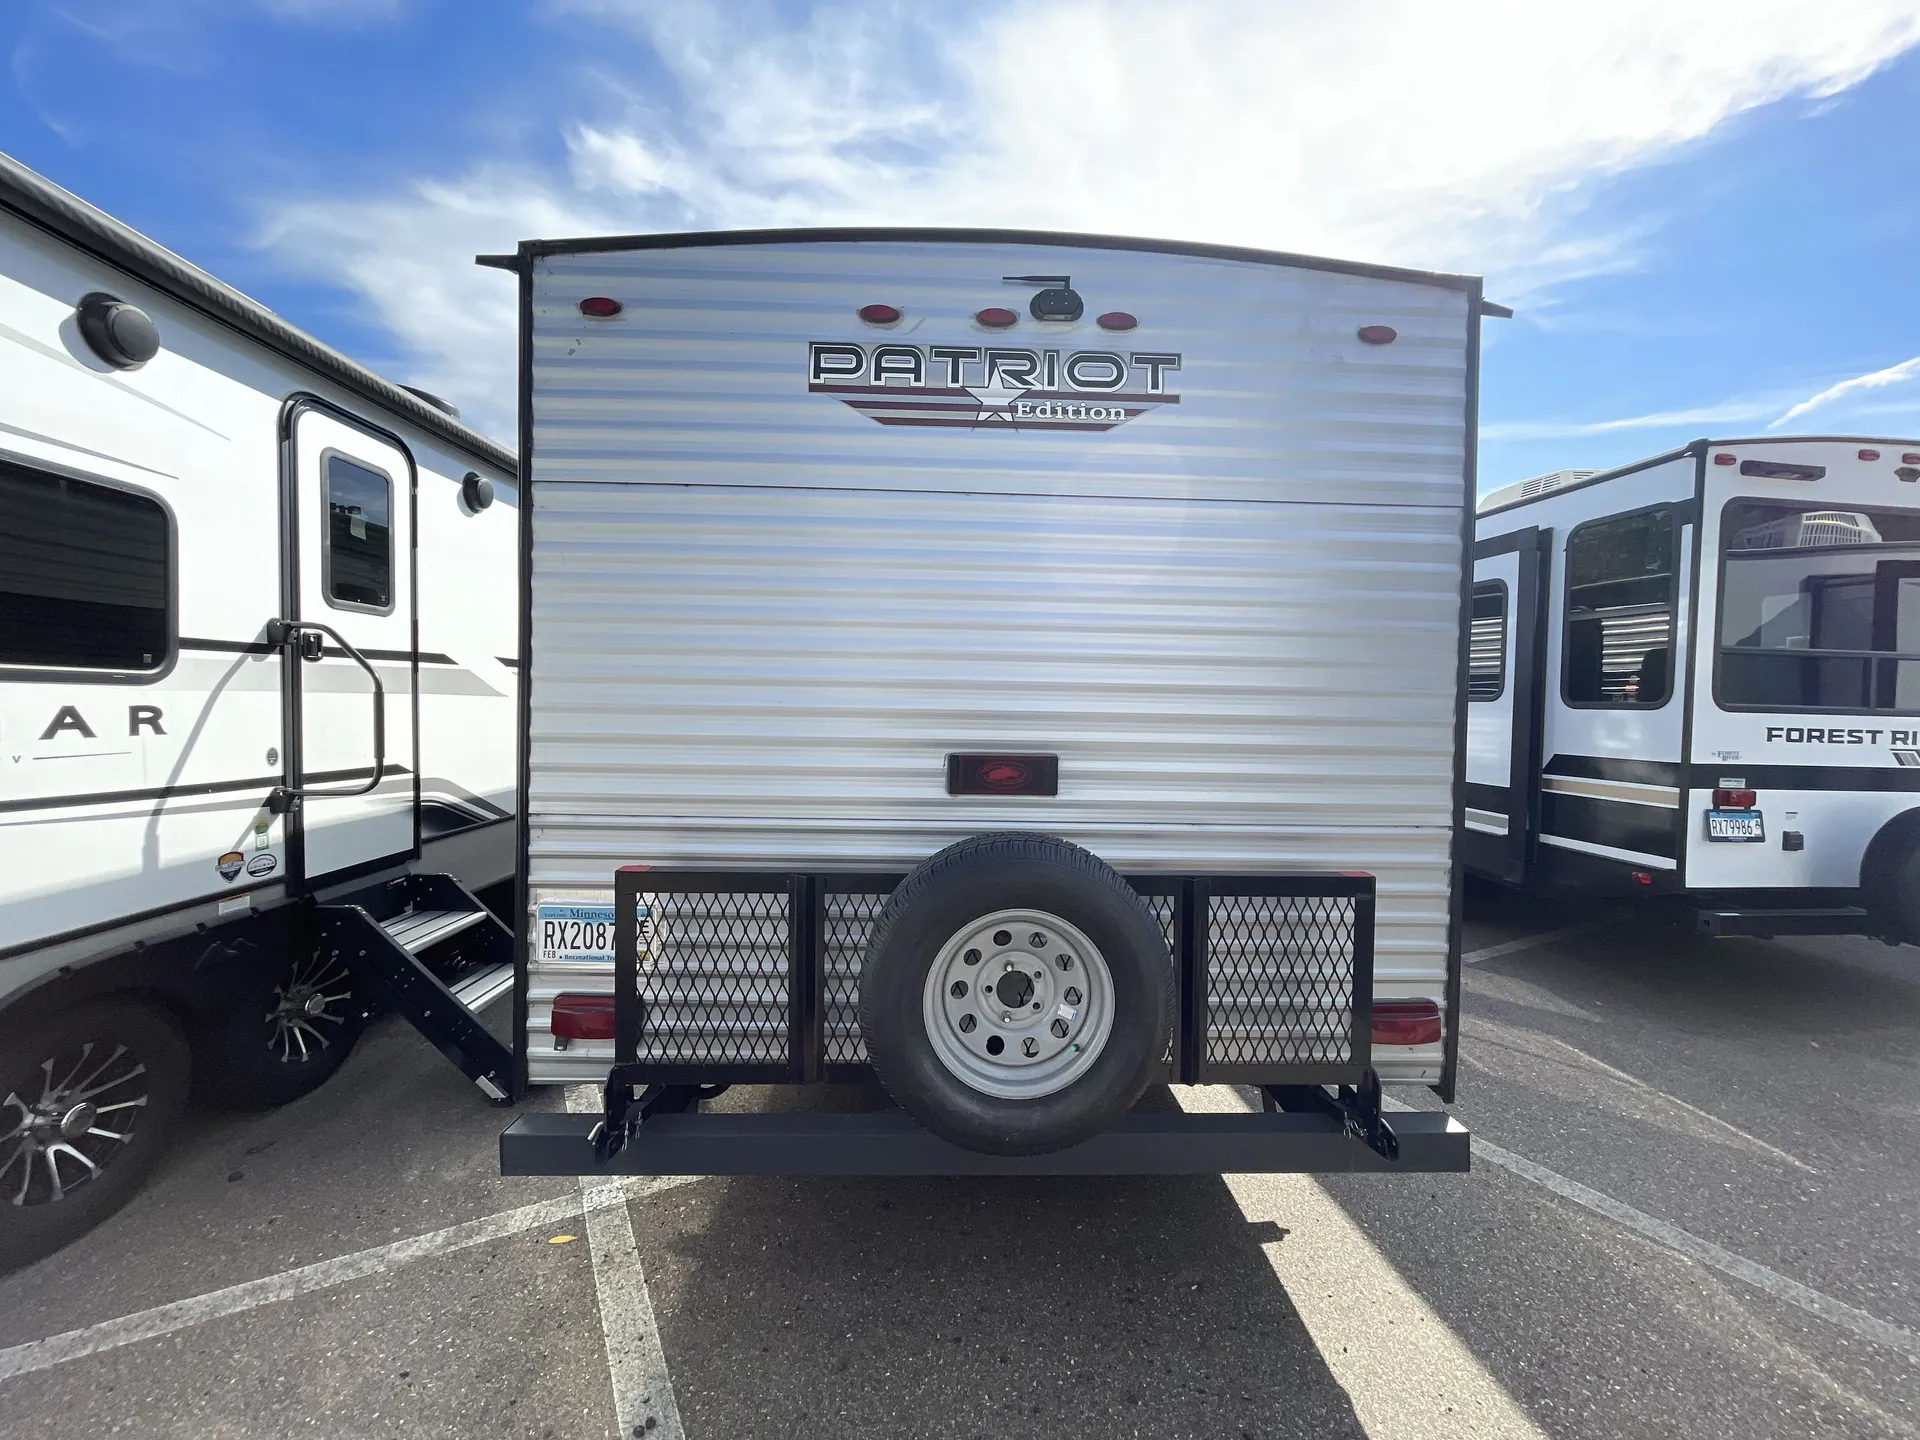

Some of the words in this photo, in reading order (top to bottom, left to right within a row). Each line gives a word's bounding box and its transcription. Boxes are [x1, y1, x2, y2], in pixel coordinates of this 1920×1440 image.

[808, 341, 1182, 395] PATRIOT
[1014, 401, 1128, 422] Edition
[38, 705, 168, 740] AR
[1766, 727, 1884, 745] FOREST
[1890, 730, 1919, 746] RI
[12, 755, 22, 763] V
[1711, 819, 1753, 836] RX79986
[569, 908, 615, 919] Minneso
[544, 921, 616, 950] RX2087
[543, 950, 556, 959] FEB
